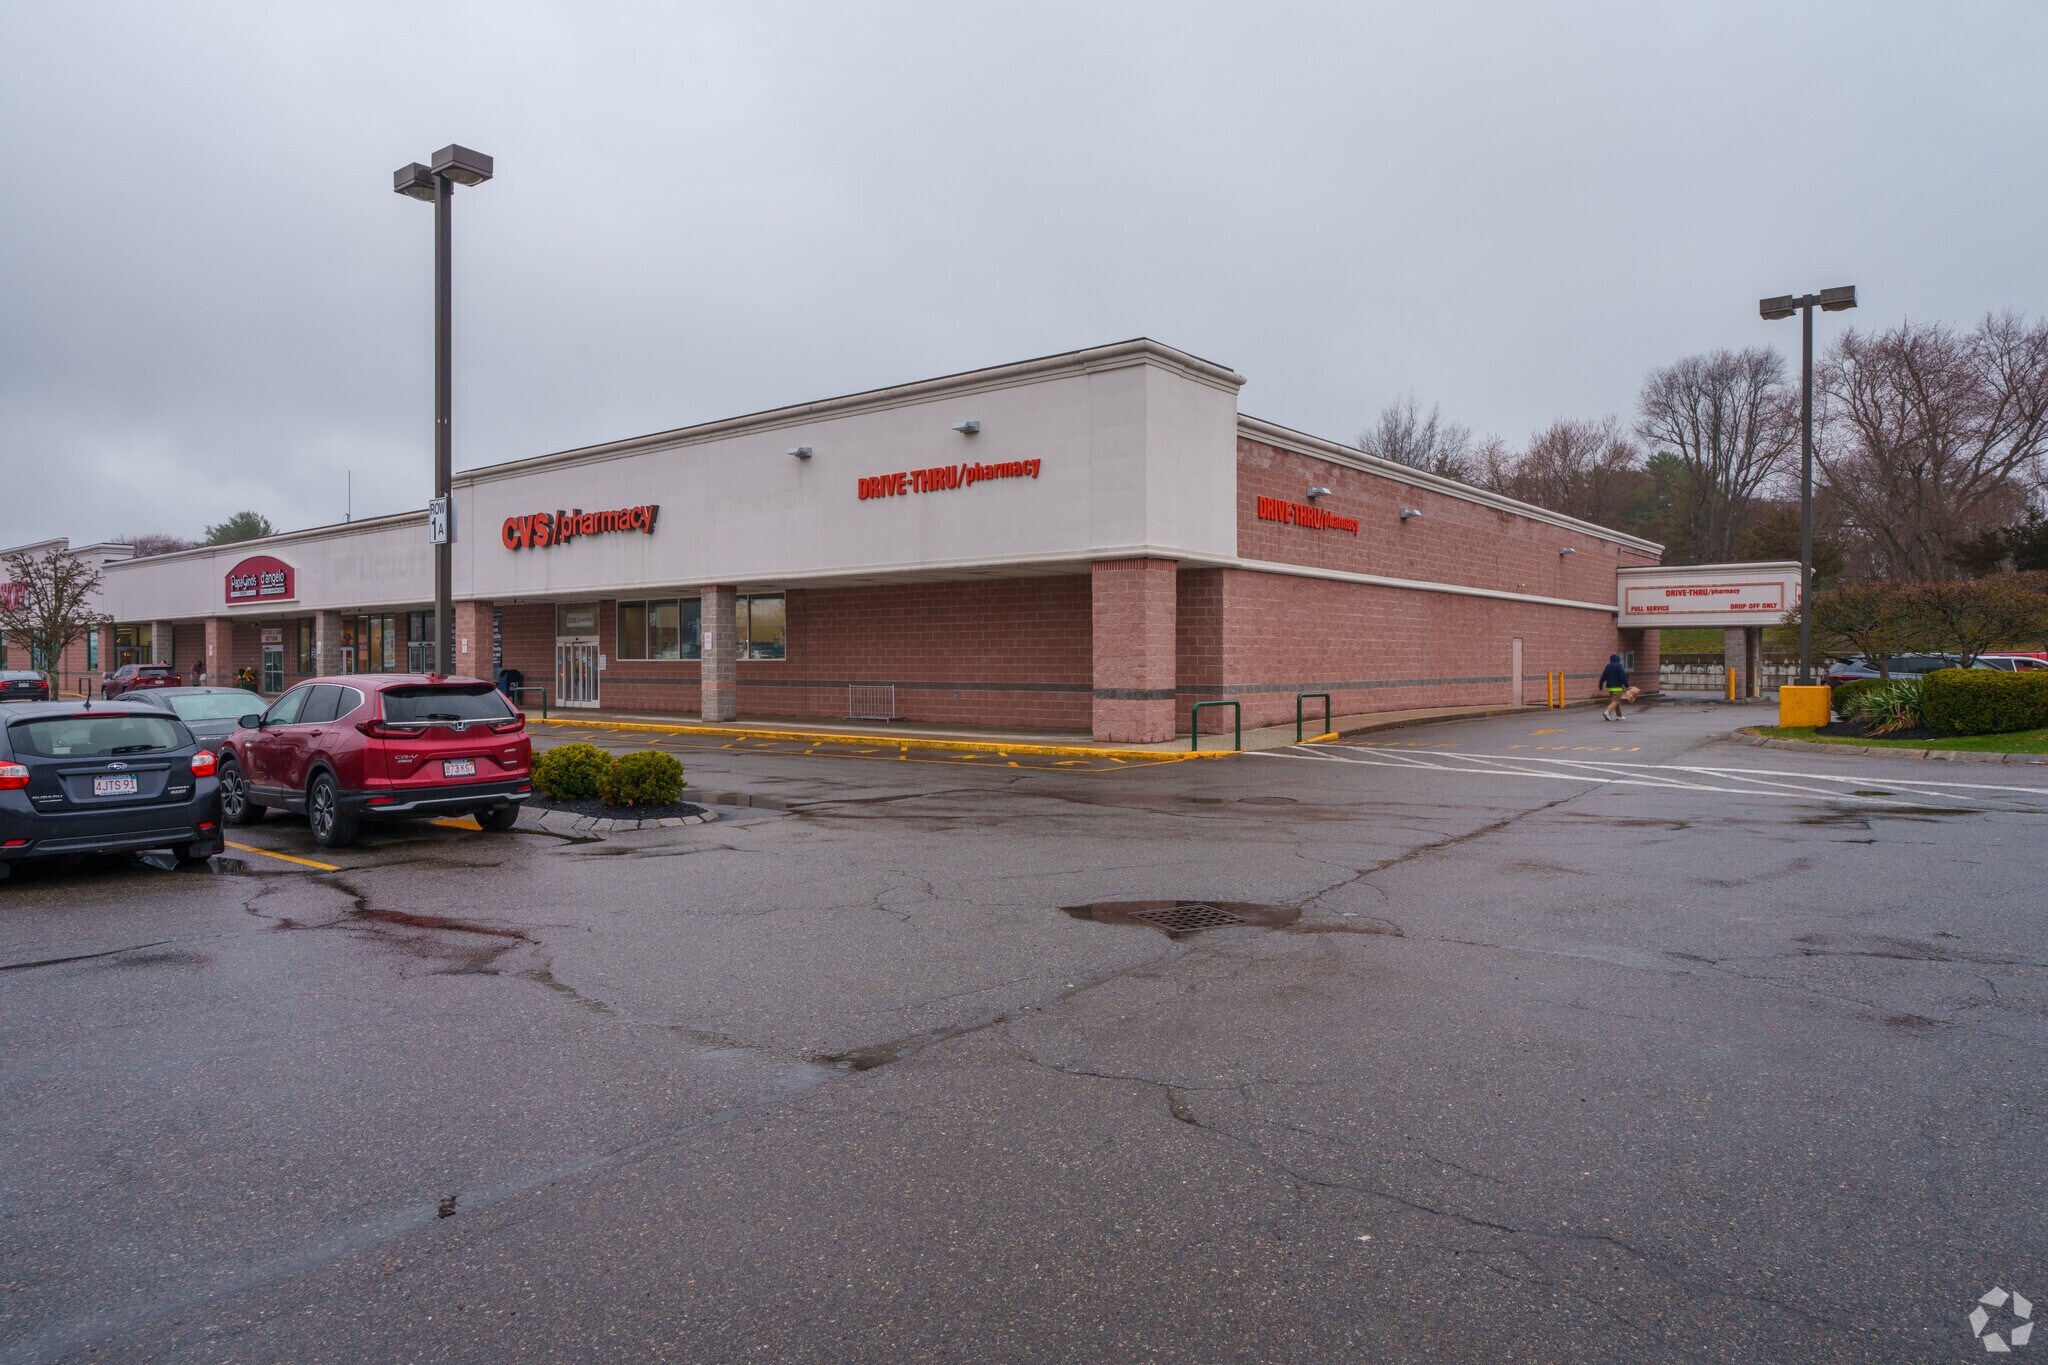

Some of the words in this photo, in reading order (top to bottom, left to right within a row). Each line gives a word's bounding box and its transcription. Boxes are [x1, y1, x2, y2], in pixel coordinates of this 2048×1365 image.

[858, 458, 1041, 500] DRIVE-THRU/pharmacy
[430, 501, 445, 515] ROW
[1258, 495, 1359, 536] DRIVE-THRU/pharmacy
[502, 504, 657, 550] CVS/pharmacy
[1665, 588, 1740, 597] DRIVE-THRU/pharmacy
[123, 779, 136, 790] 91
